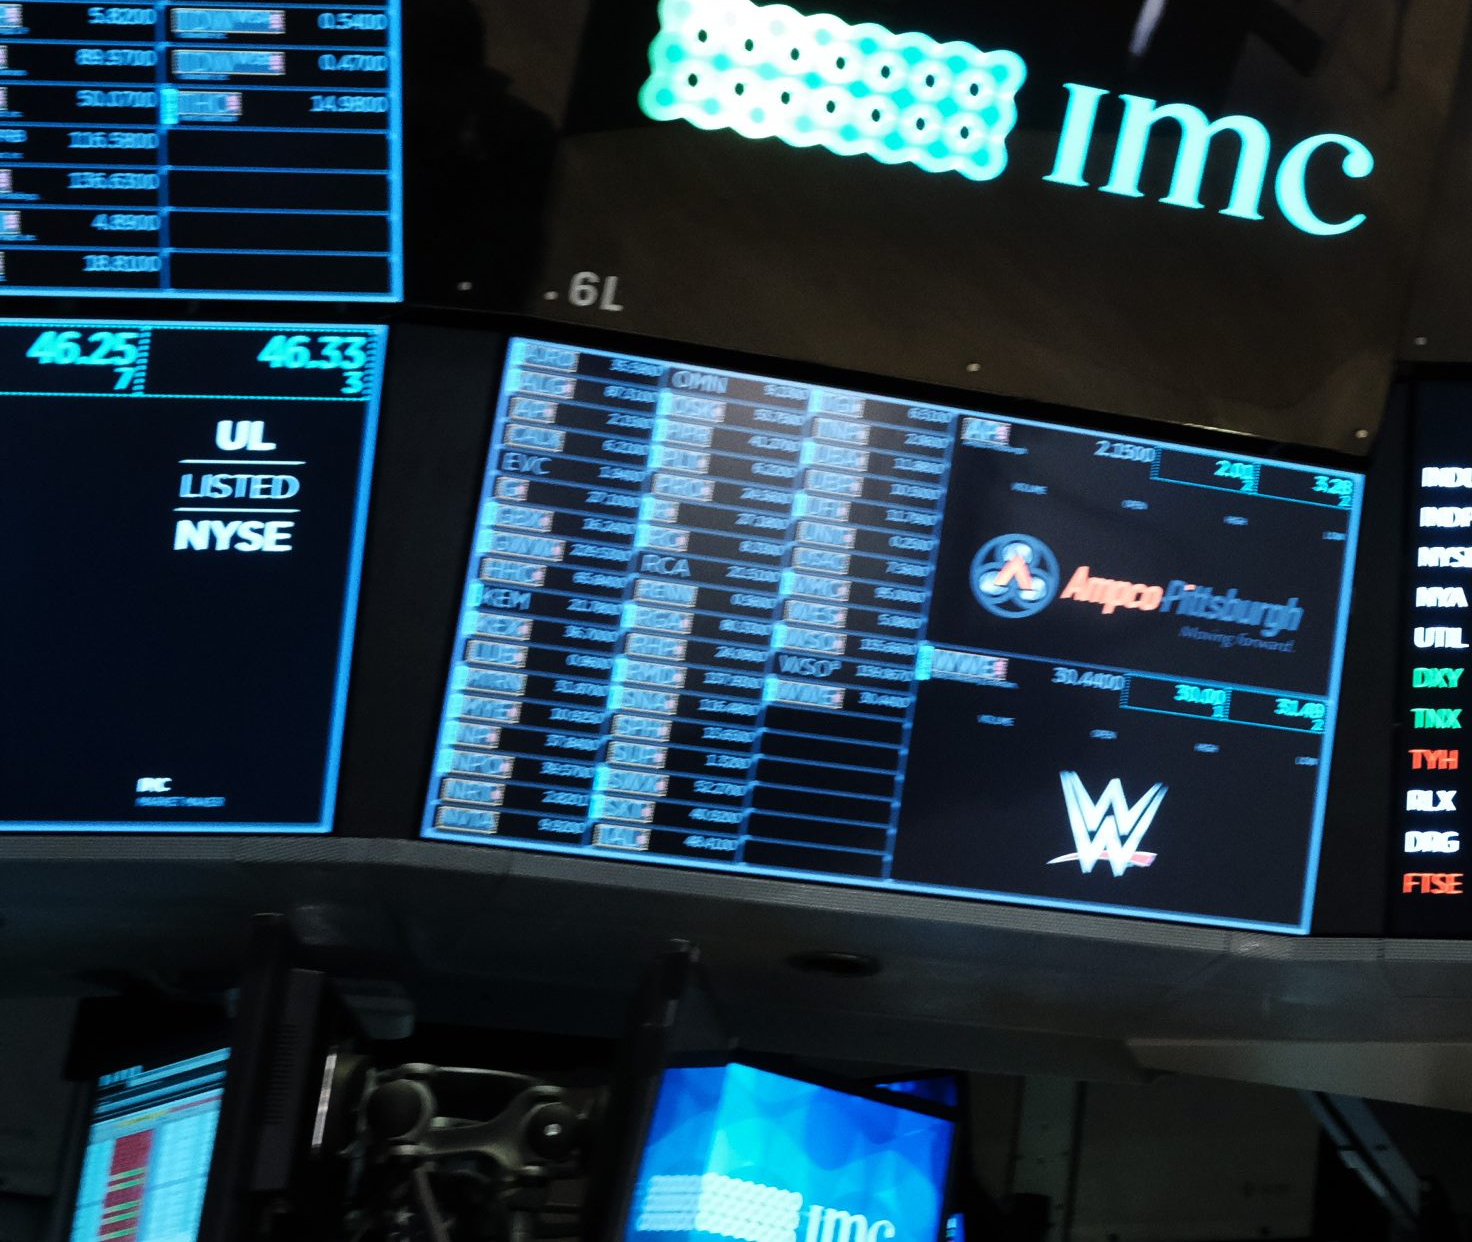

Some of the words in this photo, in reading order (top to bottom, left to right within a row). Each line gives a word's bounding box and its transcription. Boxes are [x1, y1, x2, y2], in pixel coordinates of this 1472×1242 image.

[568, 270, 624, 313] 6L
[26, 331, 138, 366] 46.25
[257, 335, 367, 370] 46.33
[214, 420, 277, 451] UL
[179, 474, 300, 500] LISTED
[174, 520, 294, 552] NYSE
[1059, 566, 1164, 615] Ampco
[1161, 579, 1304, 638] Pittsburgh
[1412, 667, 1464, 689] DXY
[1410, 708, 1462, 730] TNX
[1408, 749, 1459, 771] TYH
[1402, 872, 1464, 895] FTSE
